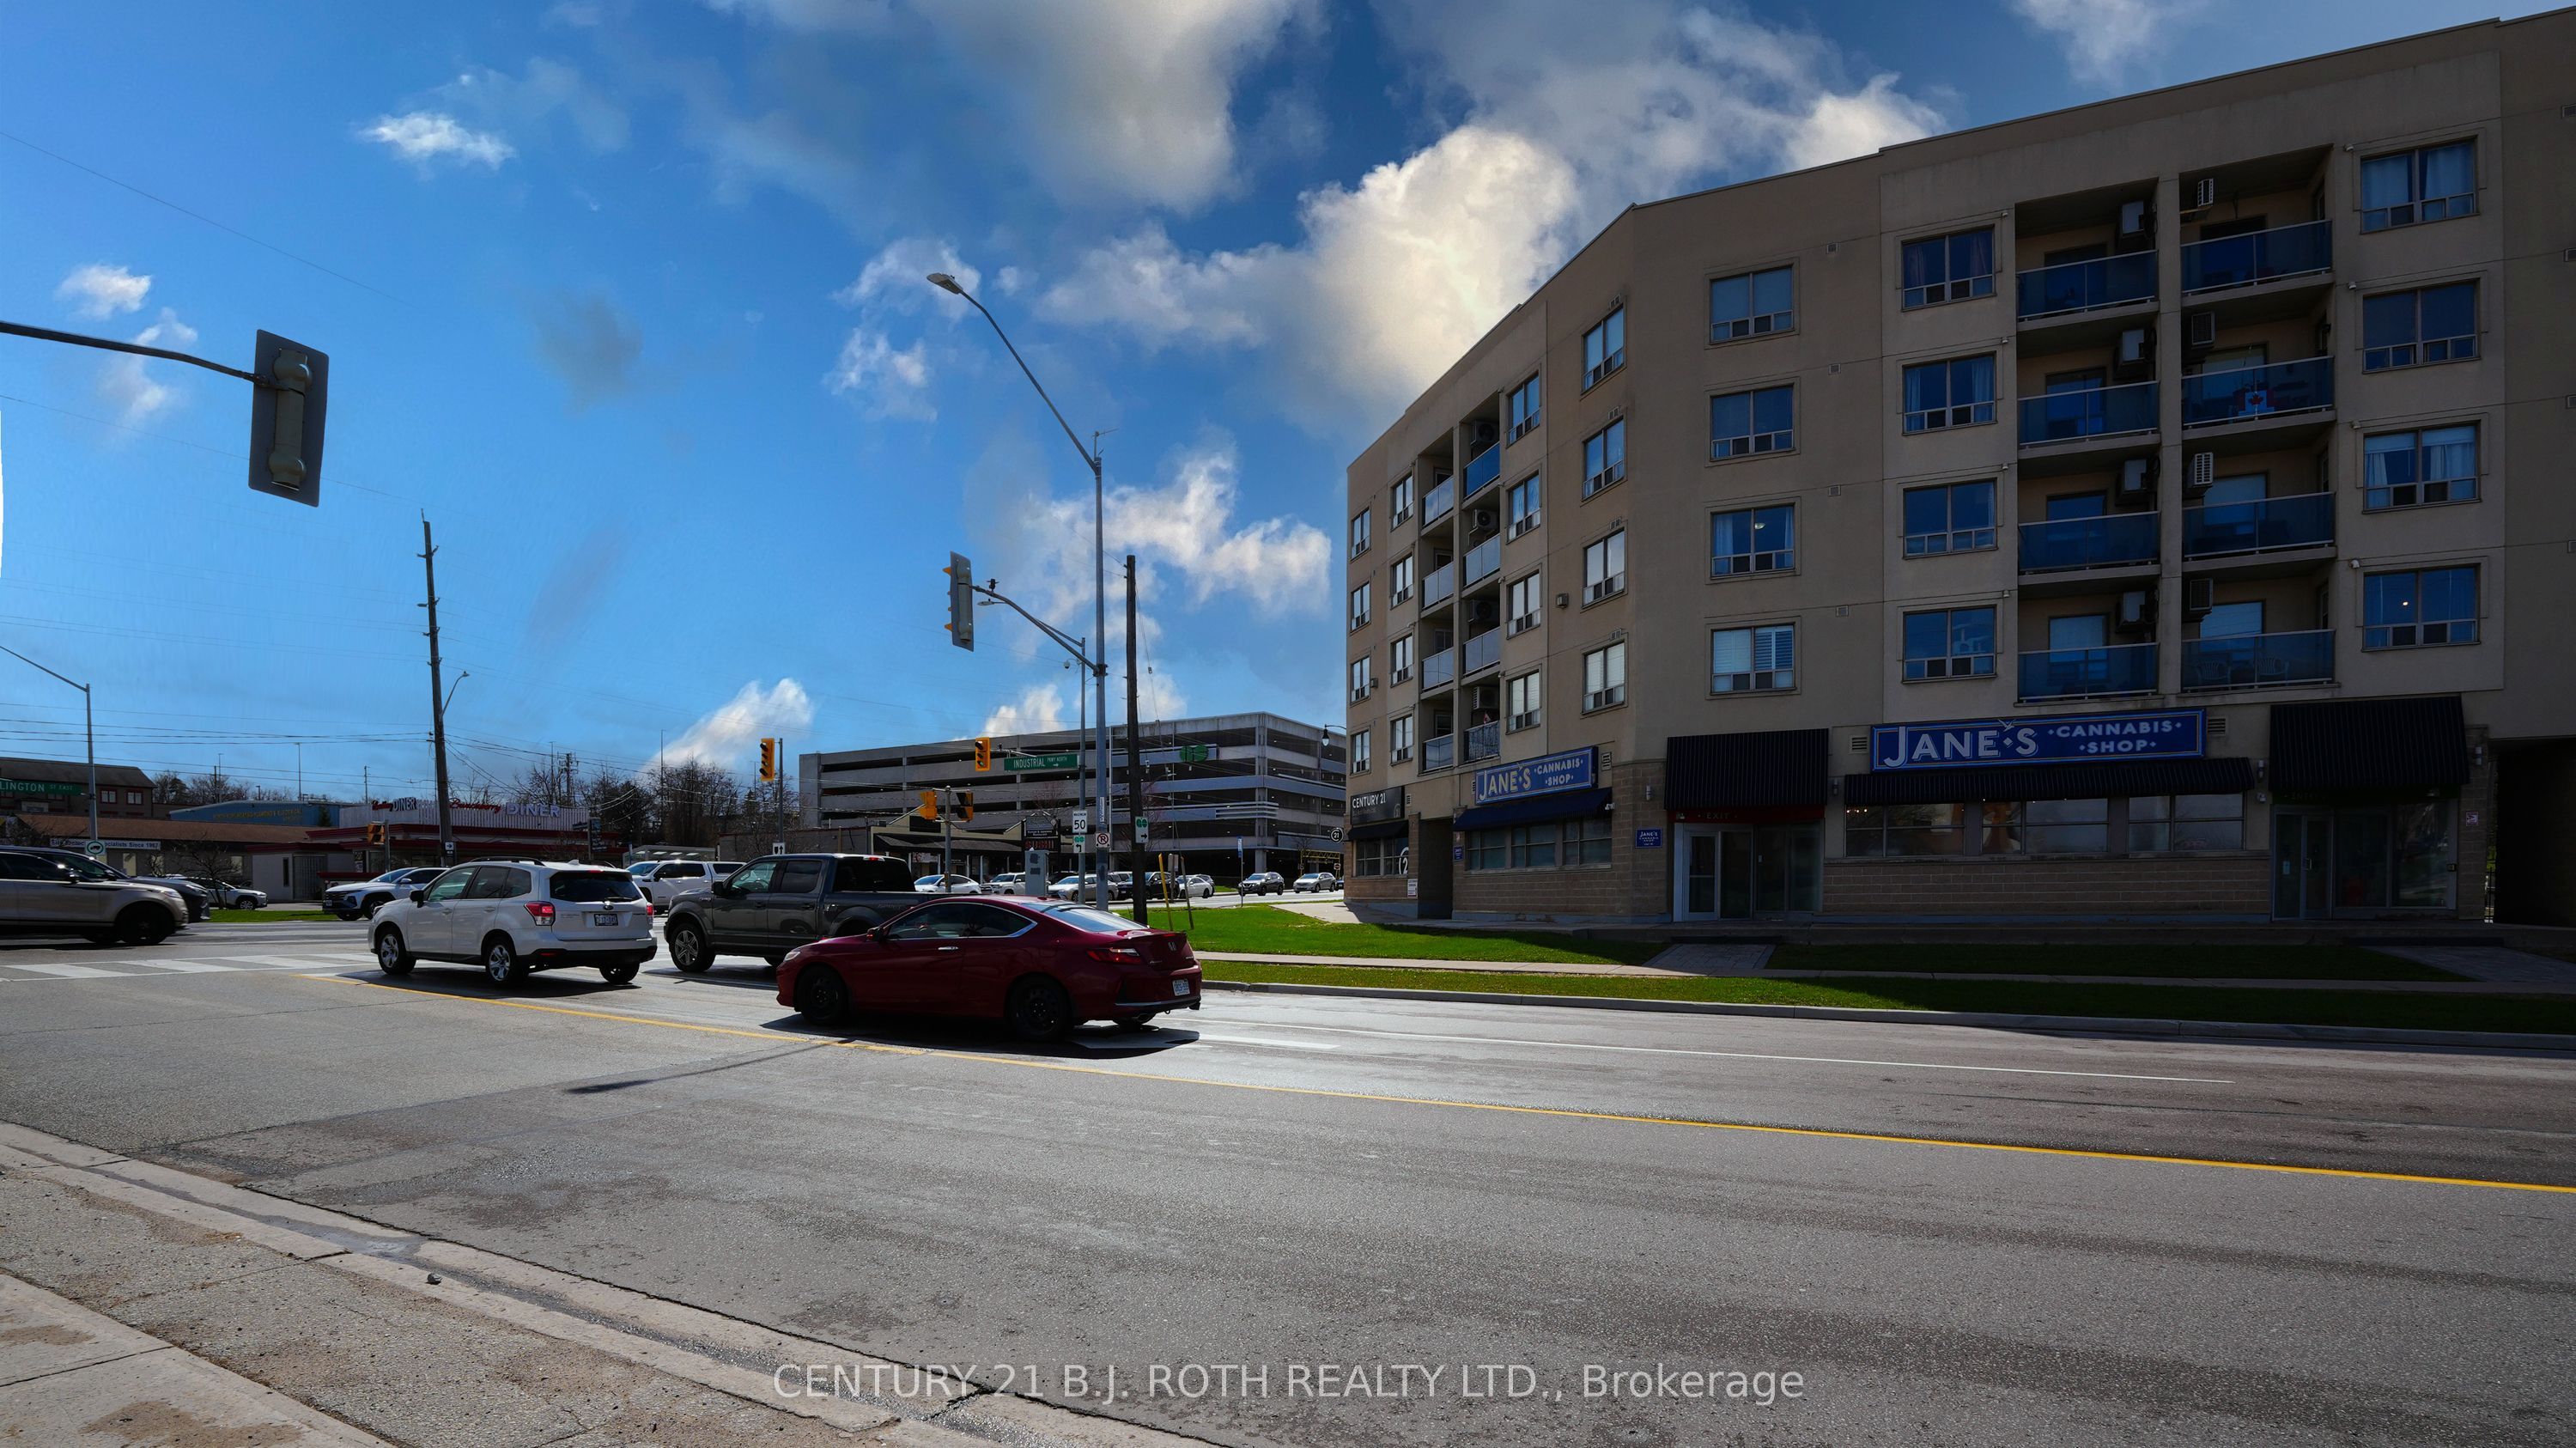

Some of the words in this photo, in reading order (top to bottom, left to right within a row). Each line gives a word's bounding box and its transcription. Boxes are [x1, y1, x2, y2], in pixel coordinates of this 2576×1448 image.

[2057, 721, 2173, 738] CANNABIS
[1884, 721, 2038, 768] JANE'S
[2087, 740, 2147, 754] SHOP
[1013, 757, 1045, 769] INDUSTRIAL
[1537, 758, 1580, 775] CANNABIS
[1479, 764, 1532, 800] JANE'S
[1548, 774, 1571, 787] SHOP
[1352, 794, 1379, 808] CENTURY
[1380, 793, 1386, 804] 21
[506, 802, 560, 818] DINER
[1074, 819, 1085, 830] 50
